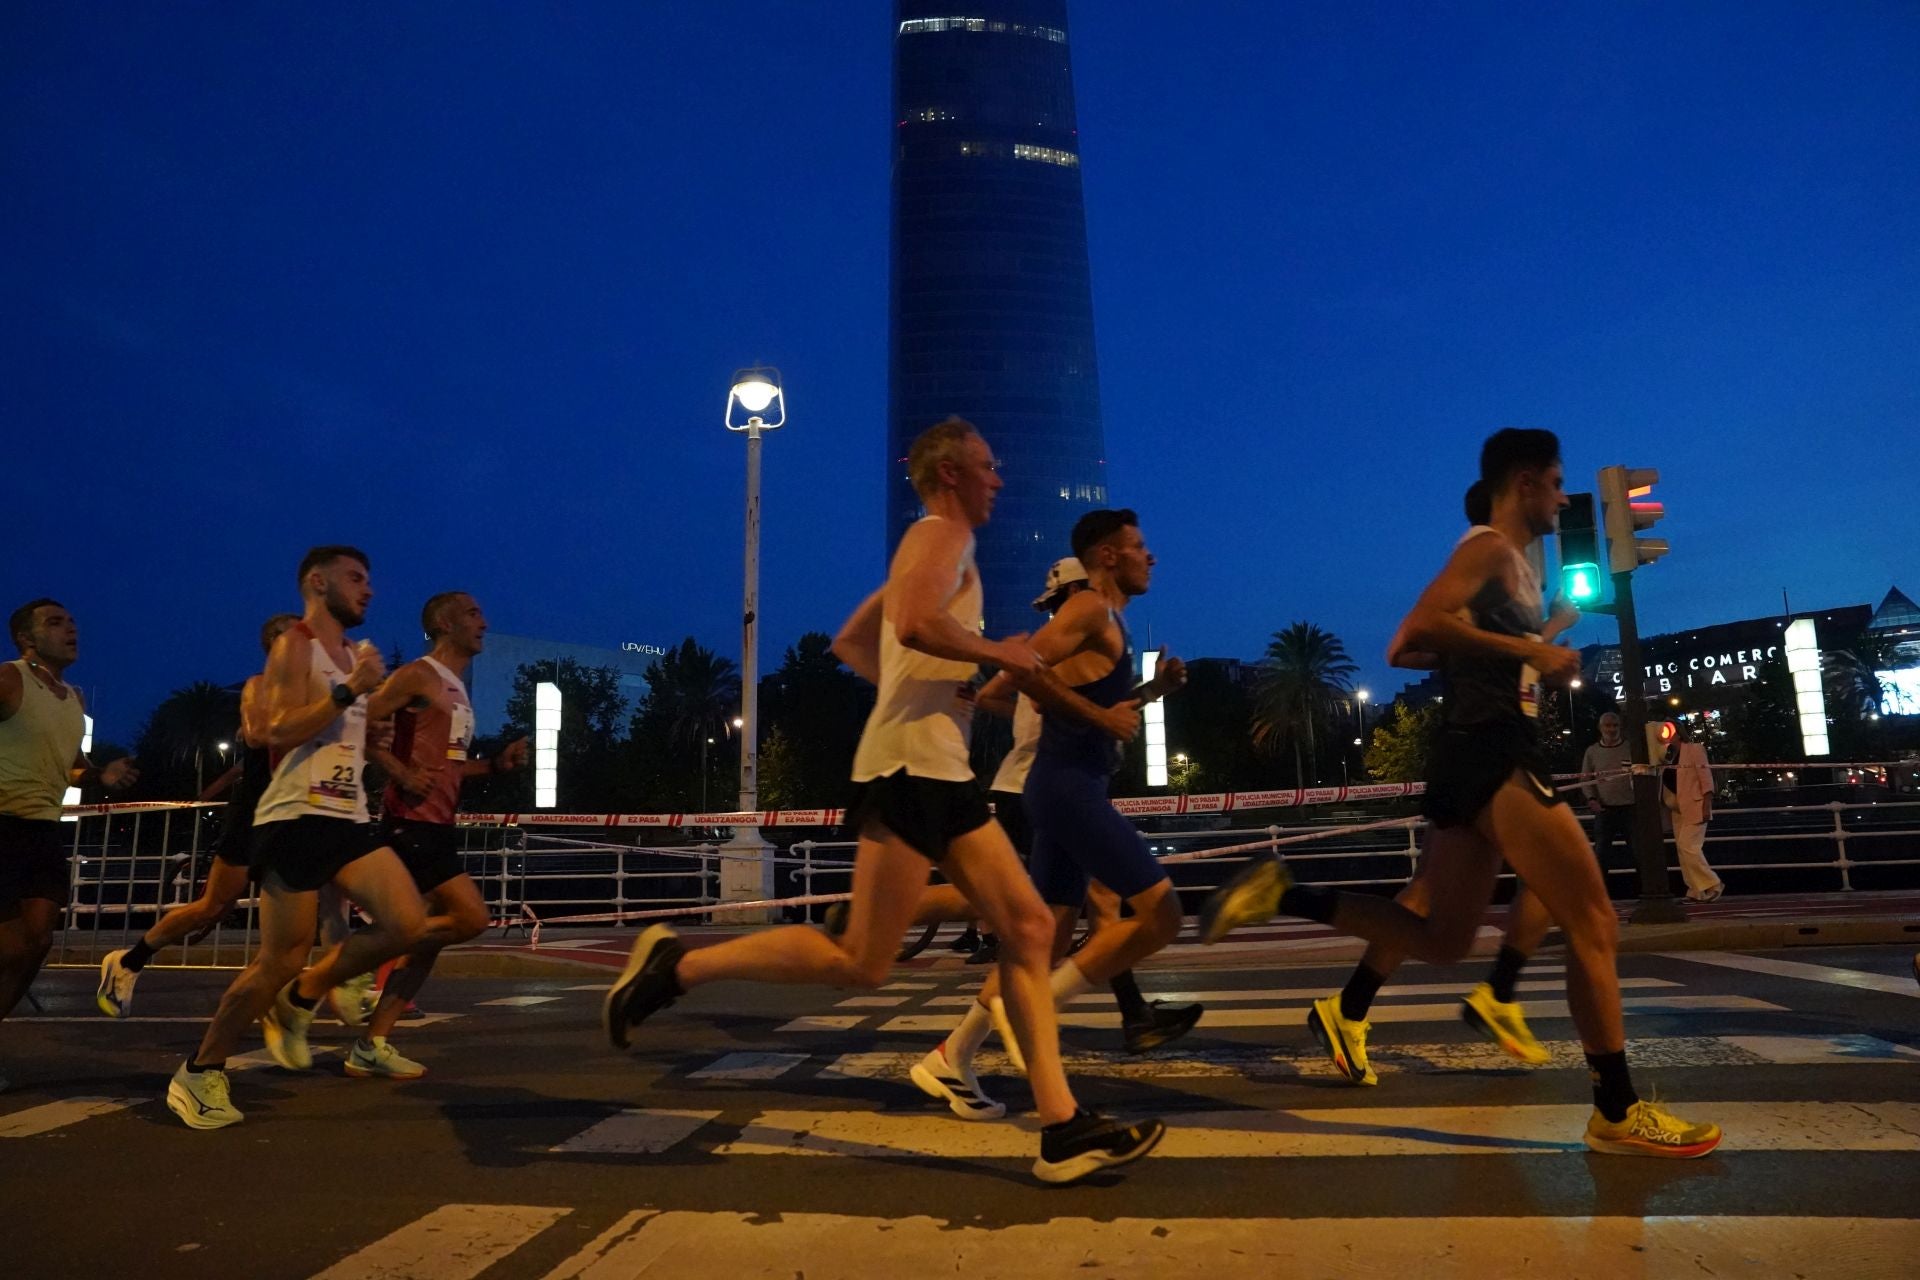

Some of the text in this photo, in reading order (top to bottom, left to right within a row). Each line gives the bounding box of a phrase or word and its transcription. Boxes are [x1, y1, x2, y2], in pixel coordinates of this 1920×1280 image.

[622, 641, 666, 656] UPV/EHU
[1613, 646, 1789, 684] CTRO COMERC
[1614, 665, 1757, 700] ZBIAR
[332, 765, 354, 783] 23
[1141, 798, 1176, 806] MUNICIPAL
[1261, 792, 1294, 800] MUNICIPAL
[531, 815, 598, 823] UDALTZAINGOA
[1630, 1121, 1681, 1145] HOKA
